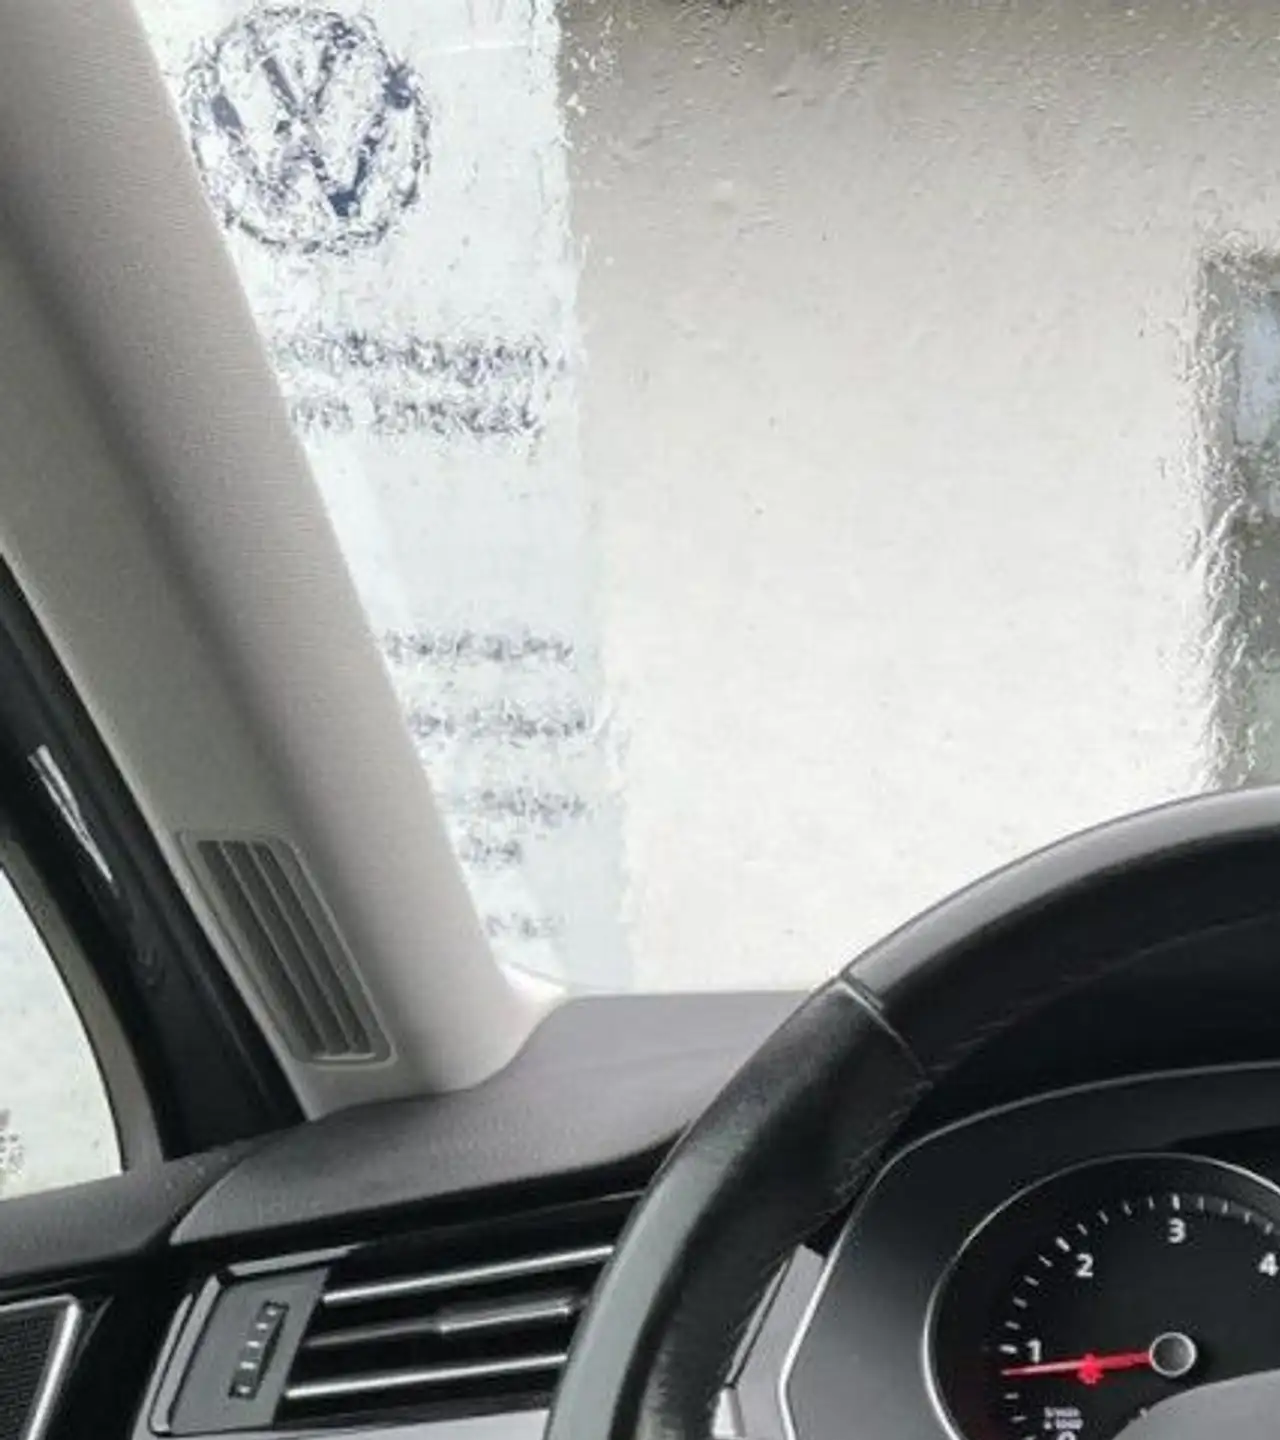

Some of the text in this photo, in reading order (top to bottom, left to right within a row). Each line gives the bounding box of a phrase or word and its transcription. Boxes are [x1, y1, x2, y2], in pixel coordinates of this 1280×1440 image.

[1169, 1218, 1185, 1243] 3
[1077, 1253, 1093, 1277] 2
[1258, 1253, 1279, 1277] 4
[1027, 1340, 1041, 1361] 1
